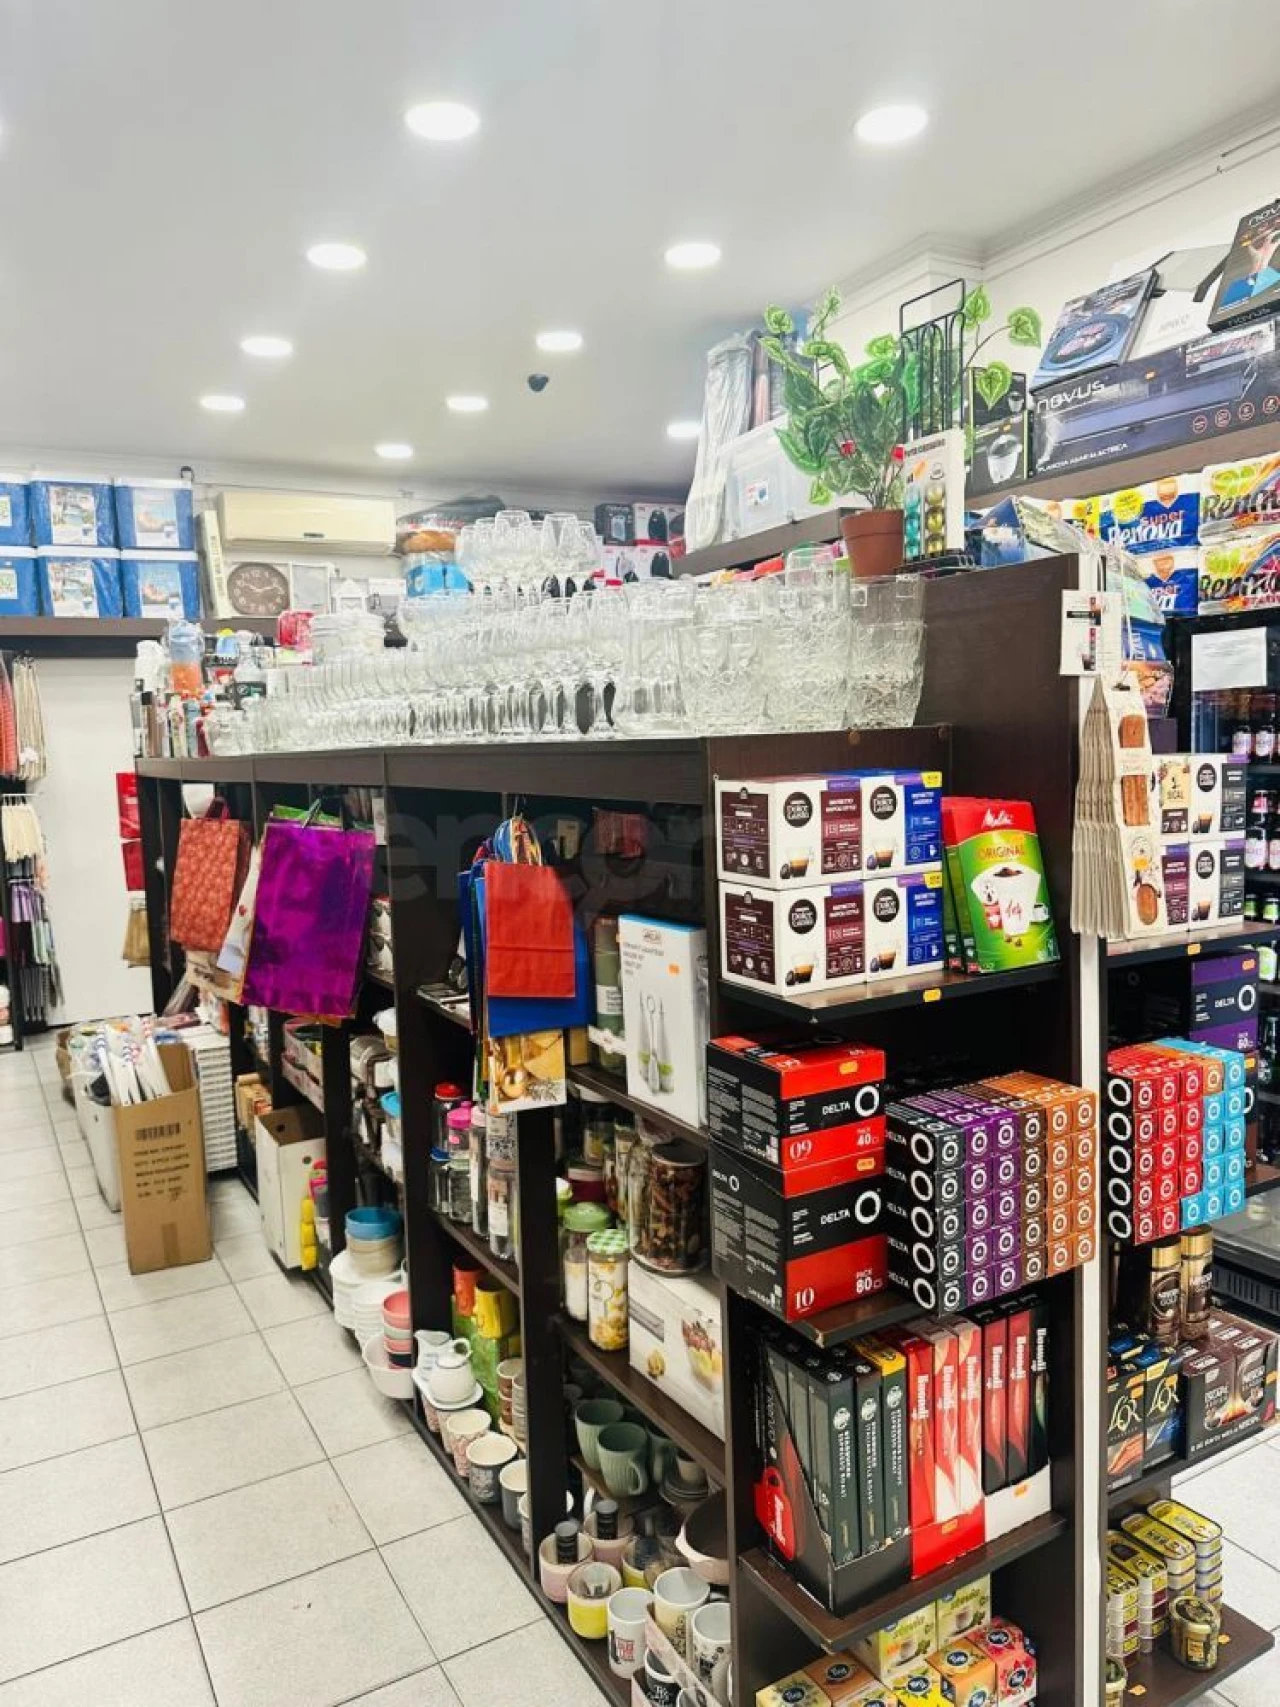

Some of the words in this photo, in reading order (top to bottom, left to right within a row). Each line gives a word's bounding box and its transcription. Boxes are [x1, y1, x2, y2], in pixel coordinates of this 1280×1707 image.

[1037, 379, 1105, 414] novus
[1140, 510, 1184, 526] Super
[1108, 519, 1185, 545] Renova
[822, 1101, 851, 1115] DELTA
[856, 1133, 871, 1147] 40
[820, 1208, 851, 1225] DELTA
[794, 1287, 815, 1312] 10
